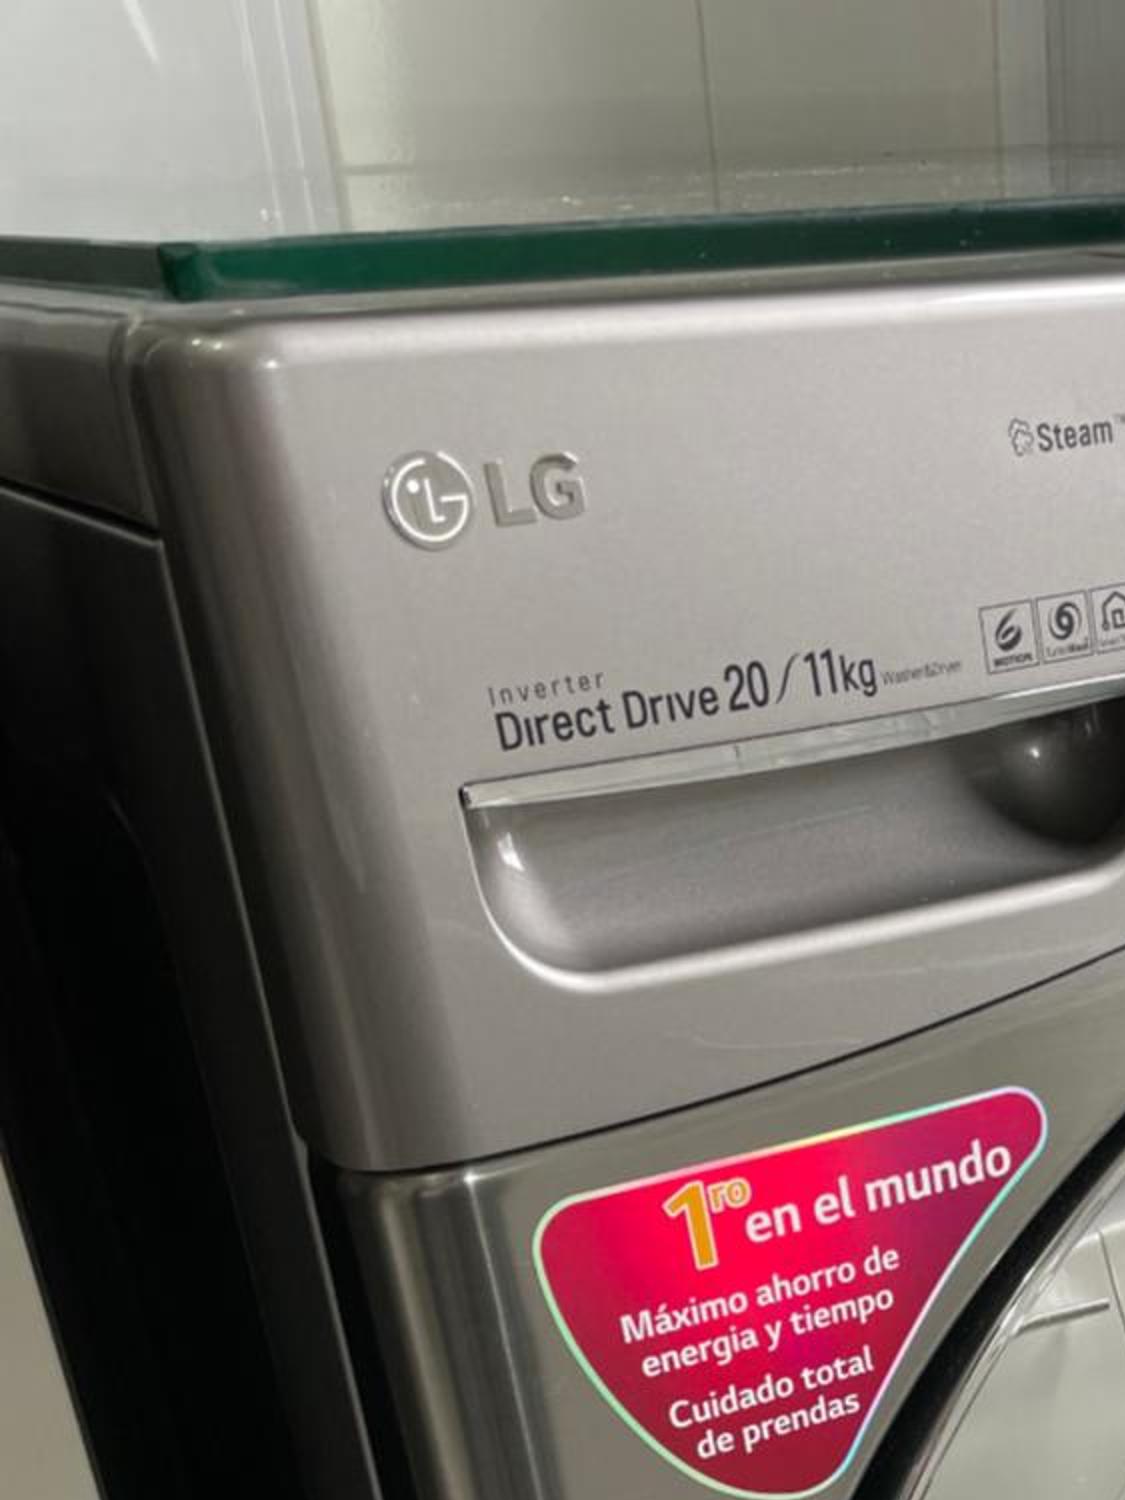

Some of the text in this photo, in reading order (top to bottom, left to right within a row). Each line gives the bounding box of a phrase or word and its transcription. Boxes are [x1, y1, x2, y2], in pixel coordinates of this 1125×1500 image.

[483, 451, 588, 528] LG
[487, 671, 605, 708] Inverter
[494, 698, 616, 752] Direct
[621, 684, 720, 731] Drive
[744, 1202, 803, 1244] en
[813, 1175, 855, 1225] el
[865, 1139, 1012, 1213] mundo
[619, 1245, 901, 1345] Máximo ahorro de
[641, 1287, 895, 1378] energia y tiempo
[668, 1345, 875, 1429] Cuidado total
[696, 1391, 861, 1461] de prendas
